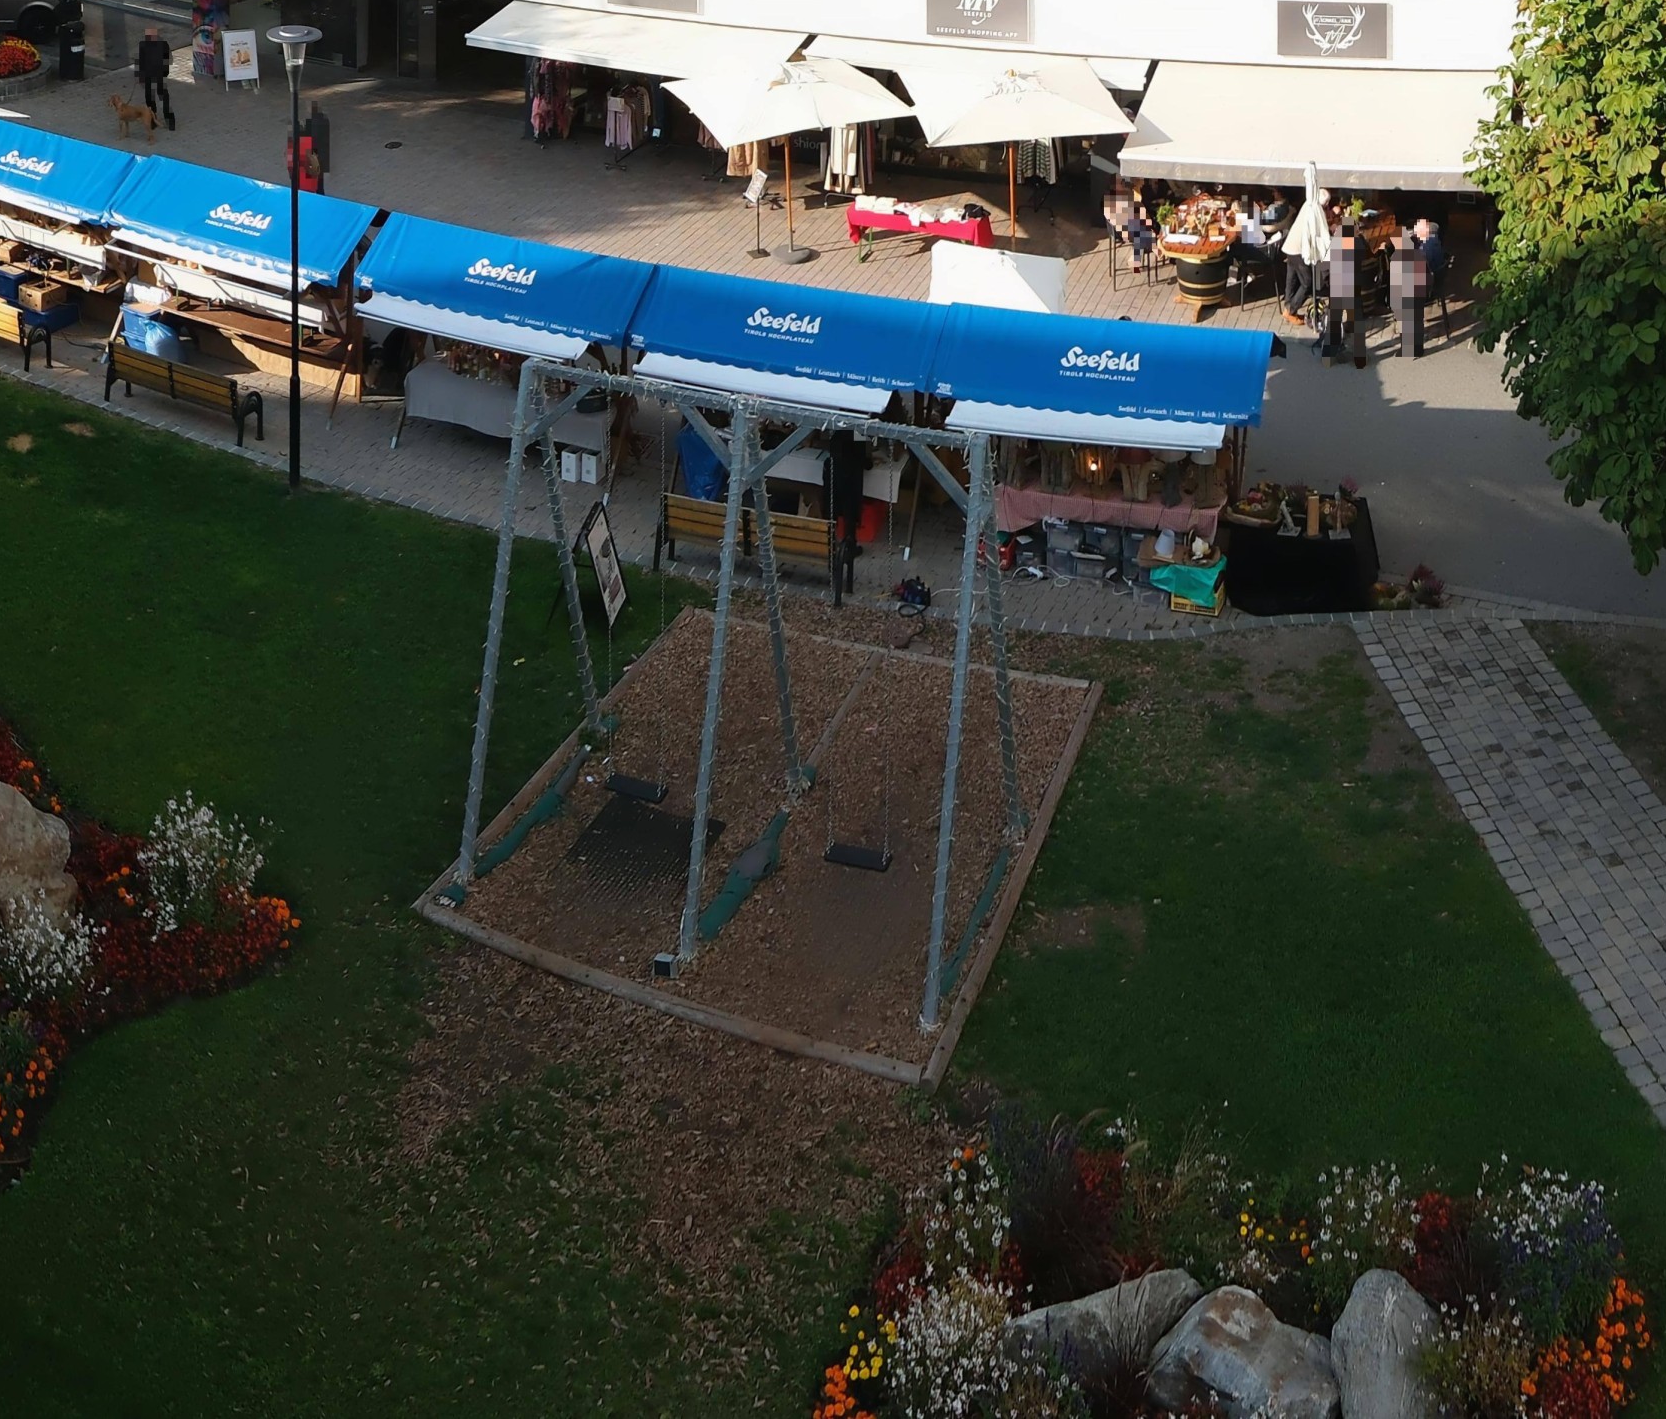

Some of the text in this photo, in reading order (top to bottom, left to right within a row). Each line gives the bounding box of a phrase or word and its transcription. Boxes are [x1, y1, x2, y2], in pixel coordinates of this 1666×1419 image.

[936, 26, 965, 34] SEEFELD
[967, 29, 1002, 37] SHOPPING
[0, 150, 54, 174] Seefeld
[209, 203, 272, 230] Seefeld
[468, 258, 537, 286] Seefeld
[746, 307, 822, 335] Seefeld
[744, 328, 814, 345] TIROLS HOCHPLATEAU
[1060, 346, 1140, 372] Seefeld
[1059, 370, 1136, 382] TIROLS HOCHPLATEAU
